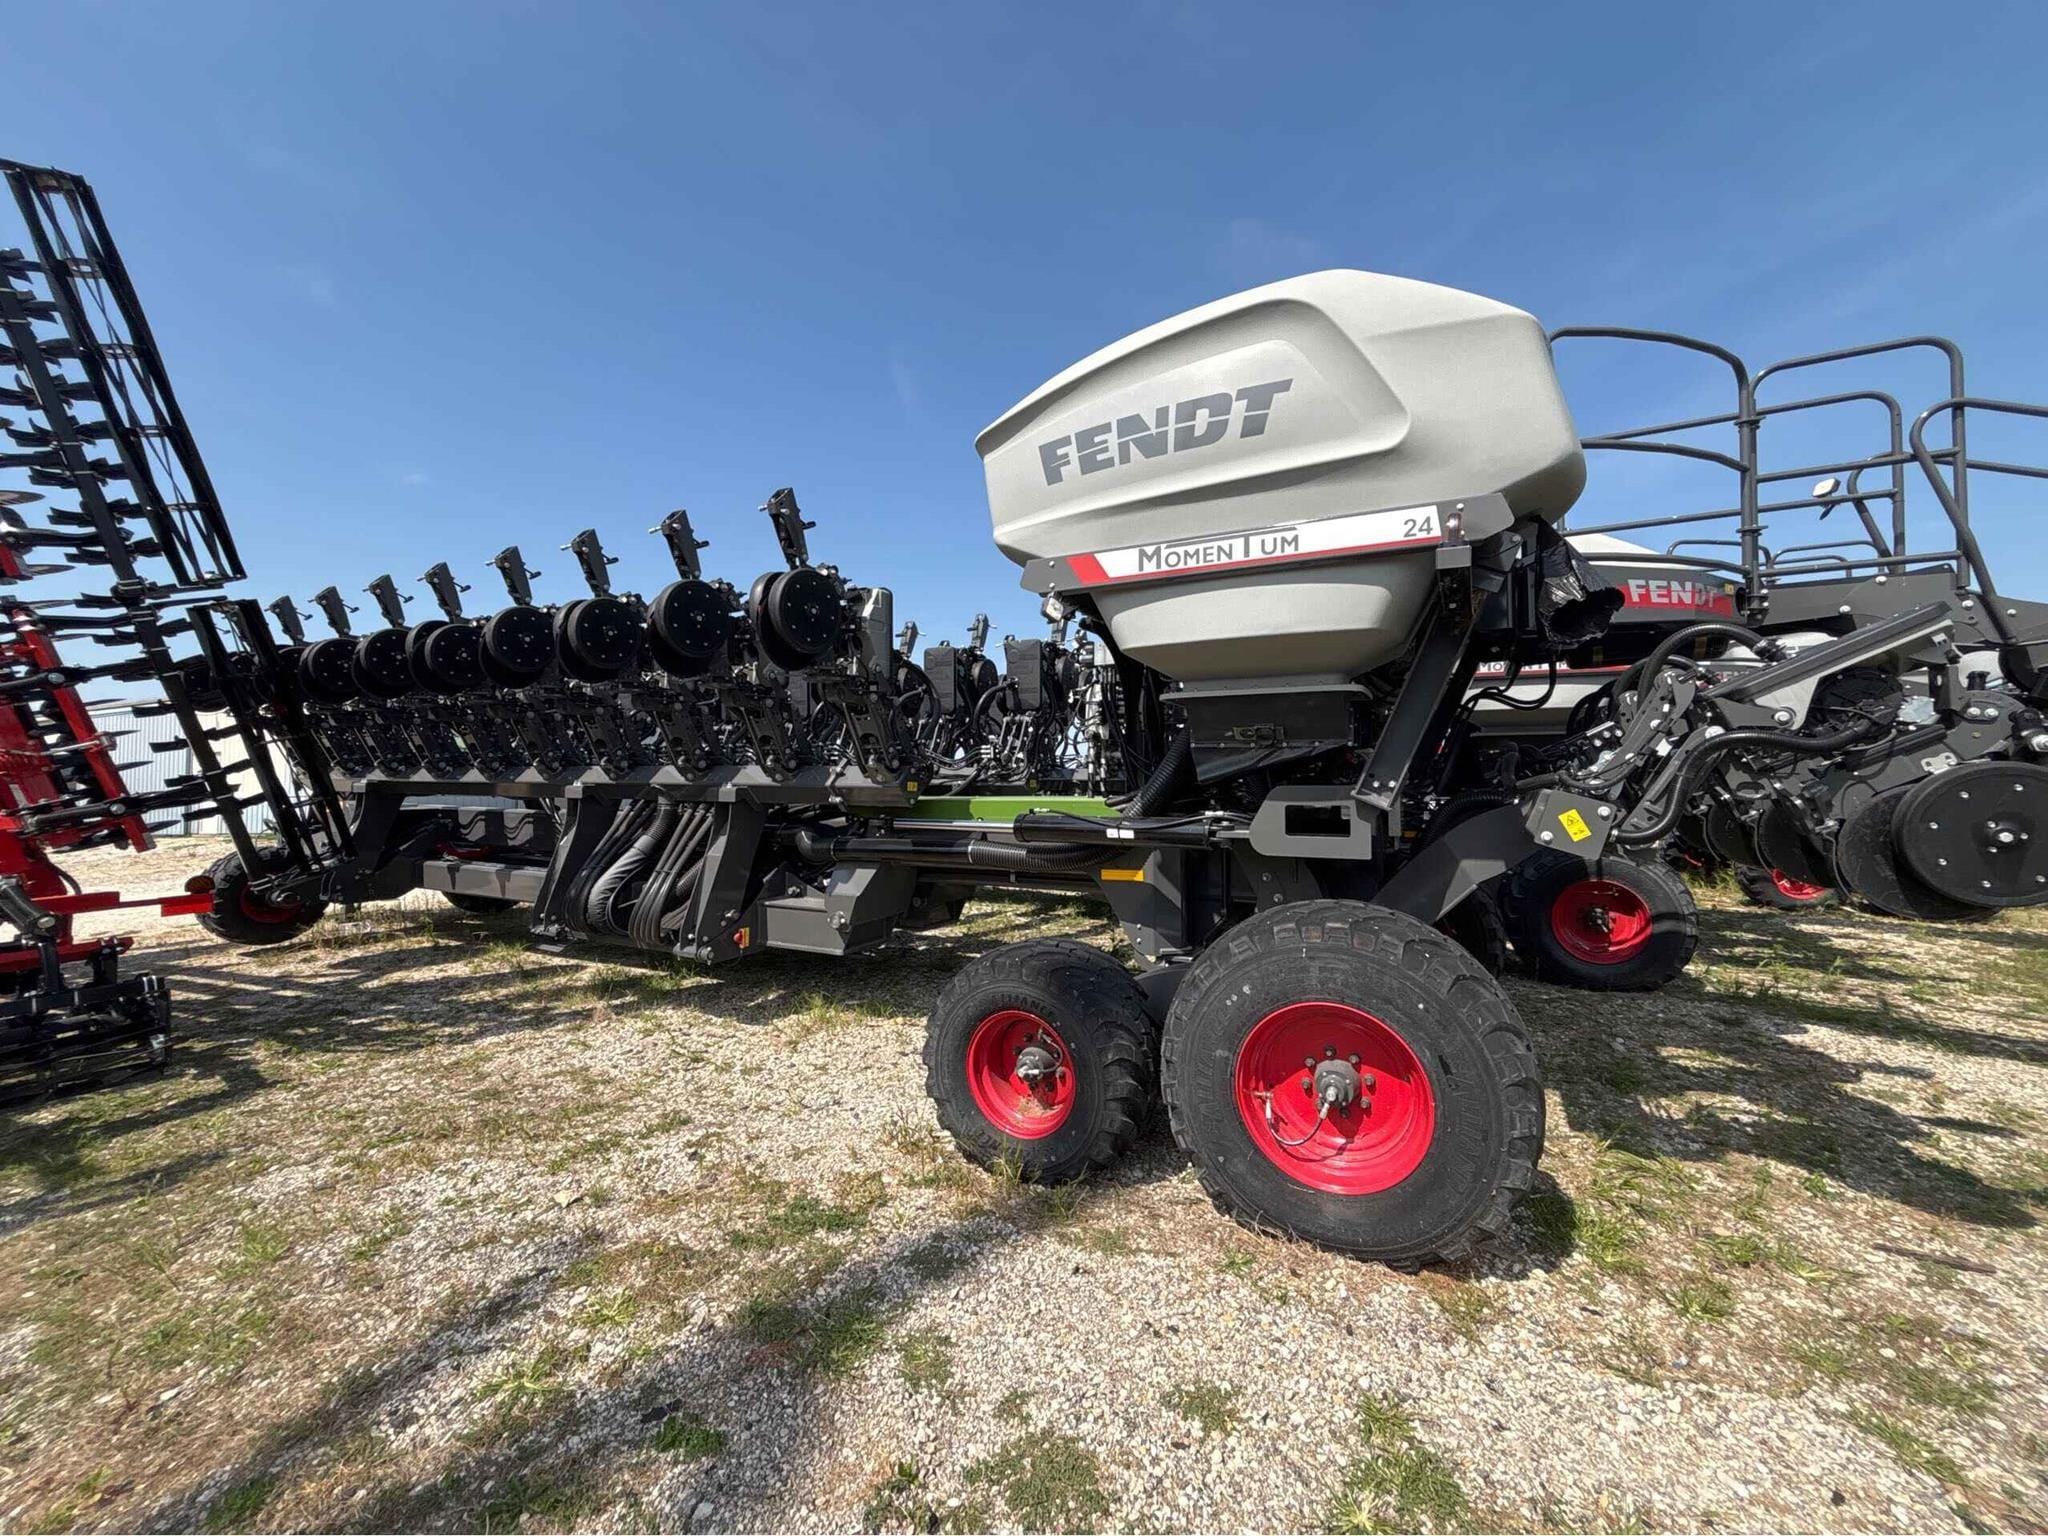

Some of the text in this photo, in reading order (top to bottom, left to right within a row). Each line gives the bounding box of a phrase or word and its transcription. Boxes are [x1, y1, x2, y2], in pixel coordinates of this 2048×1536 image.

[1038, 378, 1294, 487] FENDT
[1403, 516, 1433, 538] 24
[1627, 579, 1718, 608] FENDT
